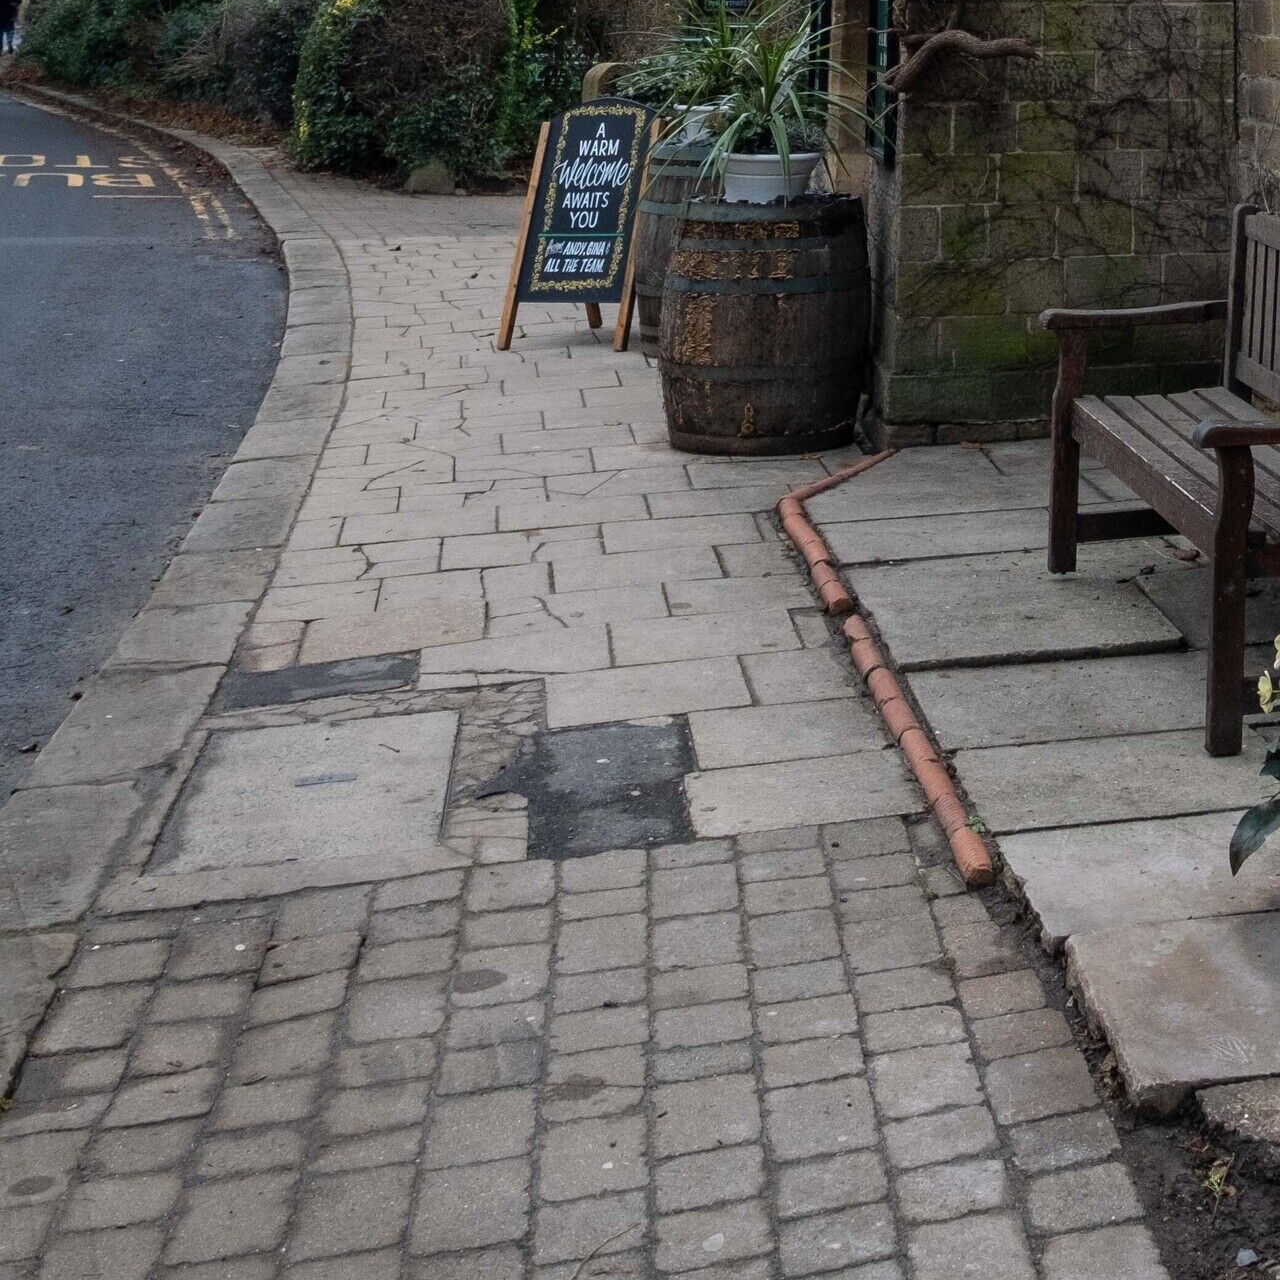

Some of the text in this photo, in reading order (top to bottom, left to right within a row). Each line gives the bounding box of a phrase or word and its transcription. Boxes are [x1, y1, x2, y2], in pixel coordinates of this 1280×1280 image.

[595, 122, 606, 139] A
[579, 139, 620, 157] WARM
[0, 173, 156, 188] BU
[552, 156, 632, 190] Welcome
[562, 192, 610, 209] AWAITS
[569, 211, 599, 229] YOU
[543, 258, 561, 273] ALL
[562, 258, 580, 273] THE
